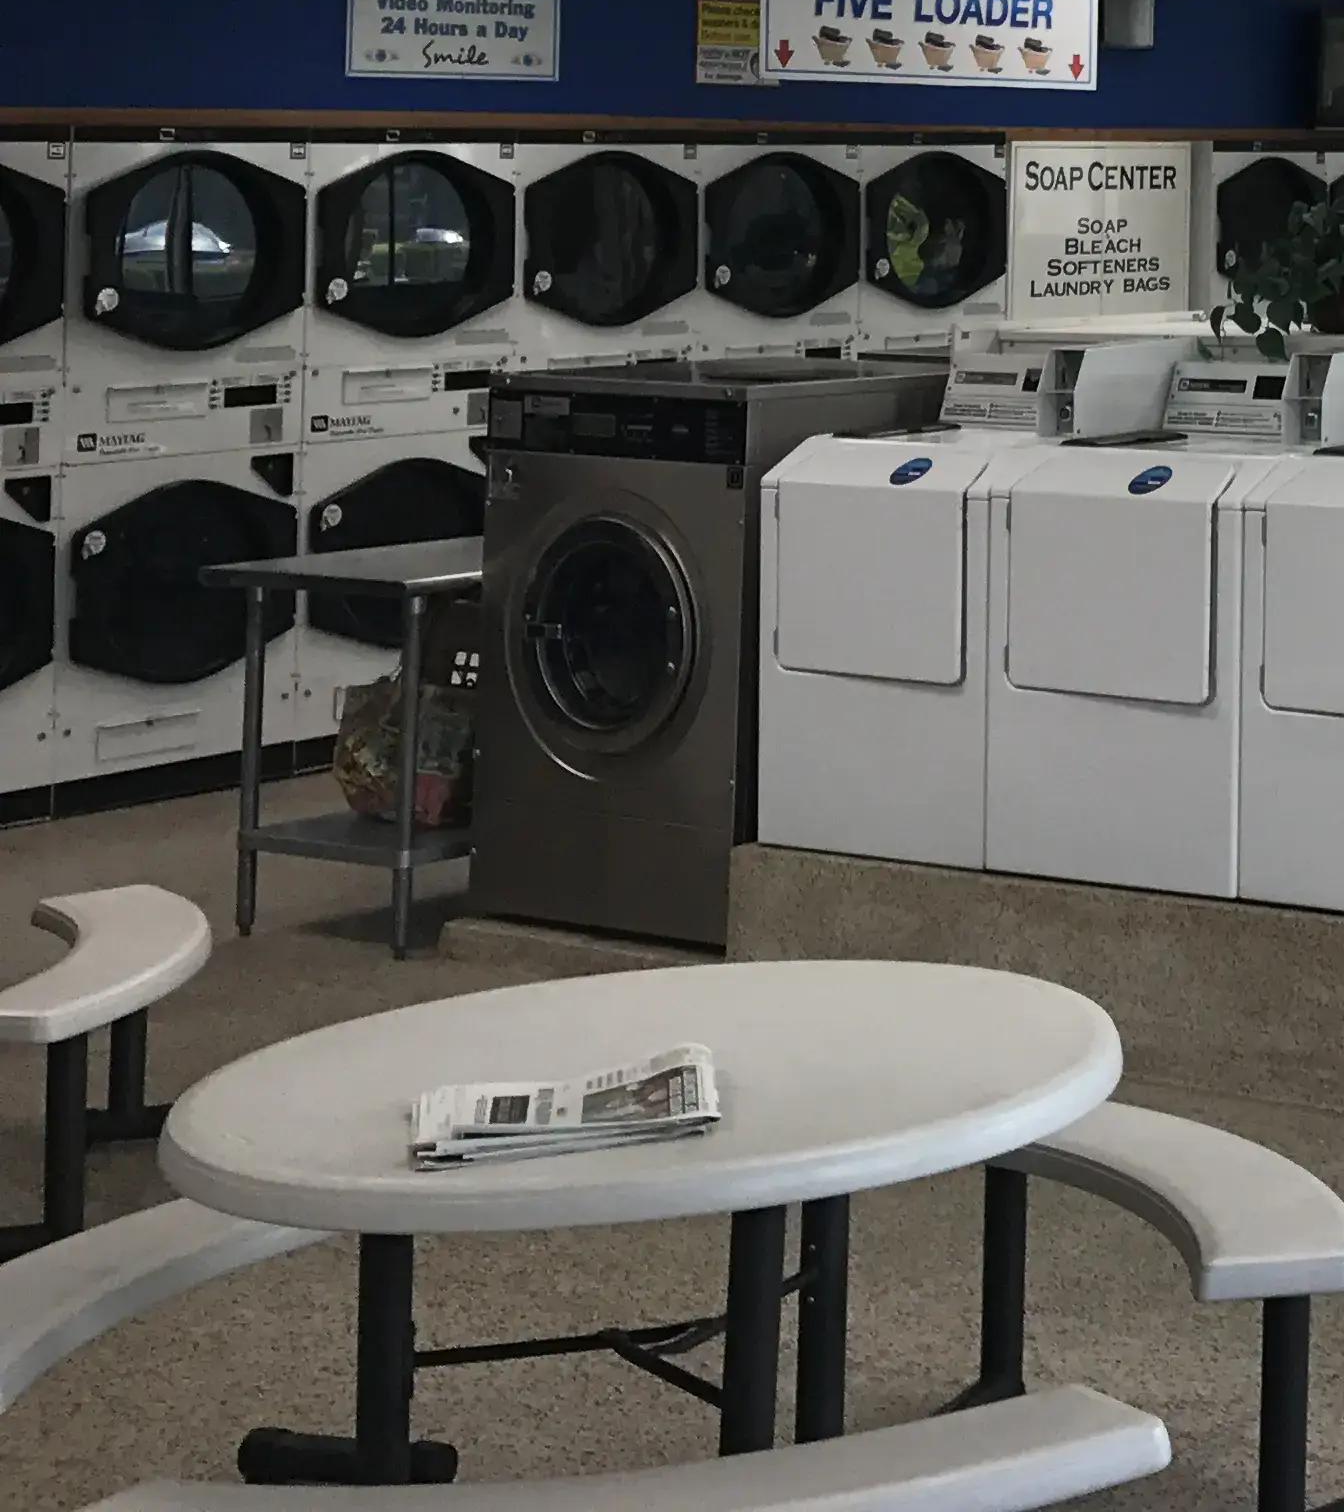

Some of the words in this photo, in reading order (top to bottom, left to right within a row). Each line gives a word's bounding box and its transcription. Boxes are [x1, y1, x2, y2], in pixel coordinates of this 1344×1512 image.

[380, 17, 406, 35] 24
[414, 18, 468, 37] Hours
[476, 24, 487, 37] a
[494, 21, 529, 41] Day
[422, 40, 489, 68] Smile
[1024, 160, 1084, 191] SOAP
[1087, 161, 1177, 191] CENTER
[1076, 217, 1128, 235] SOAP
[1064, 237, 1142, 256] BLEACH
[1046, 256, 1160, 277] SOFTENERS
[1030, 279, 1115, 298] LAUNDRY
[1123, 276, 1171, 293] BAGS
[100, 432, 146, 447] MAYTAG
